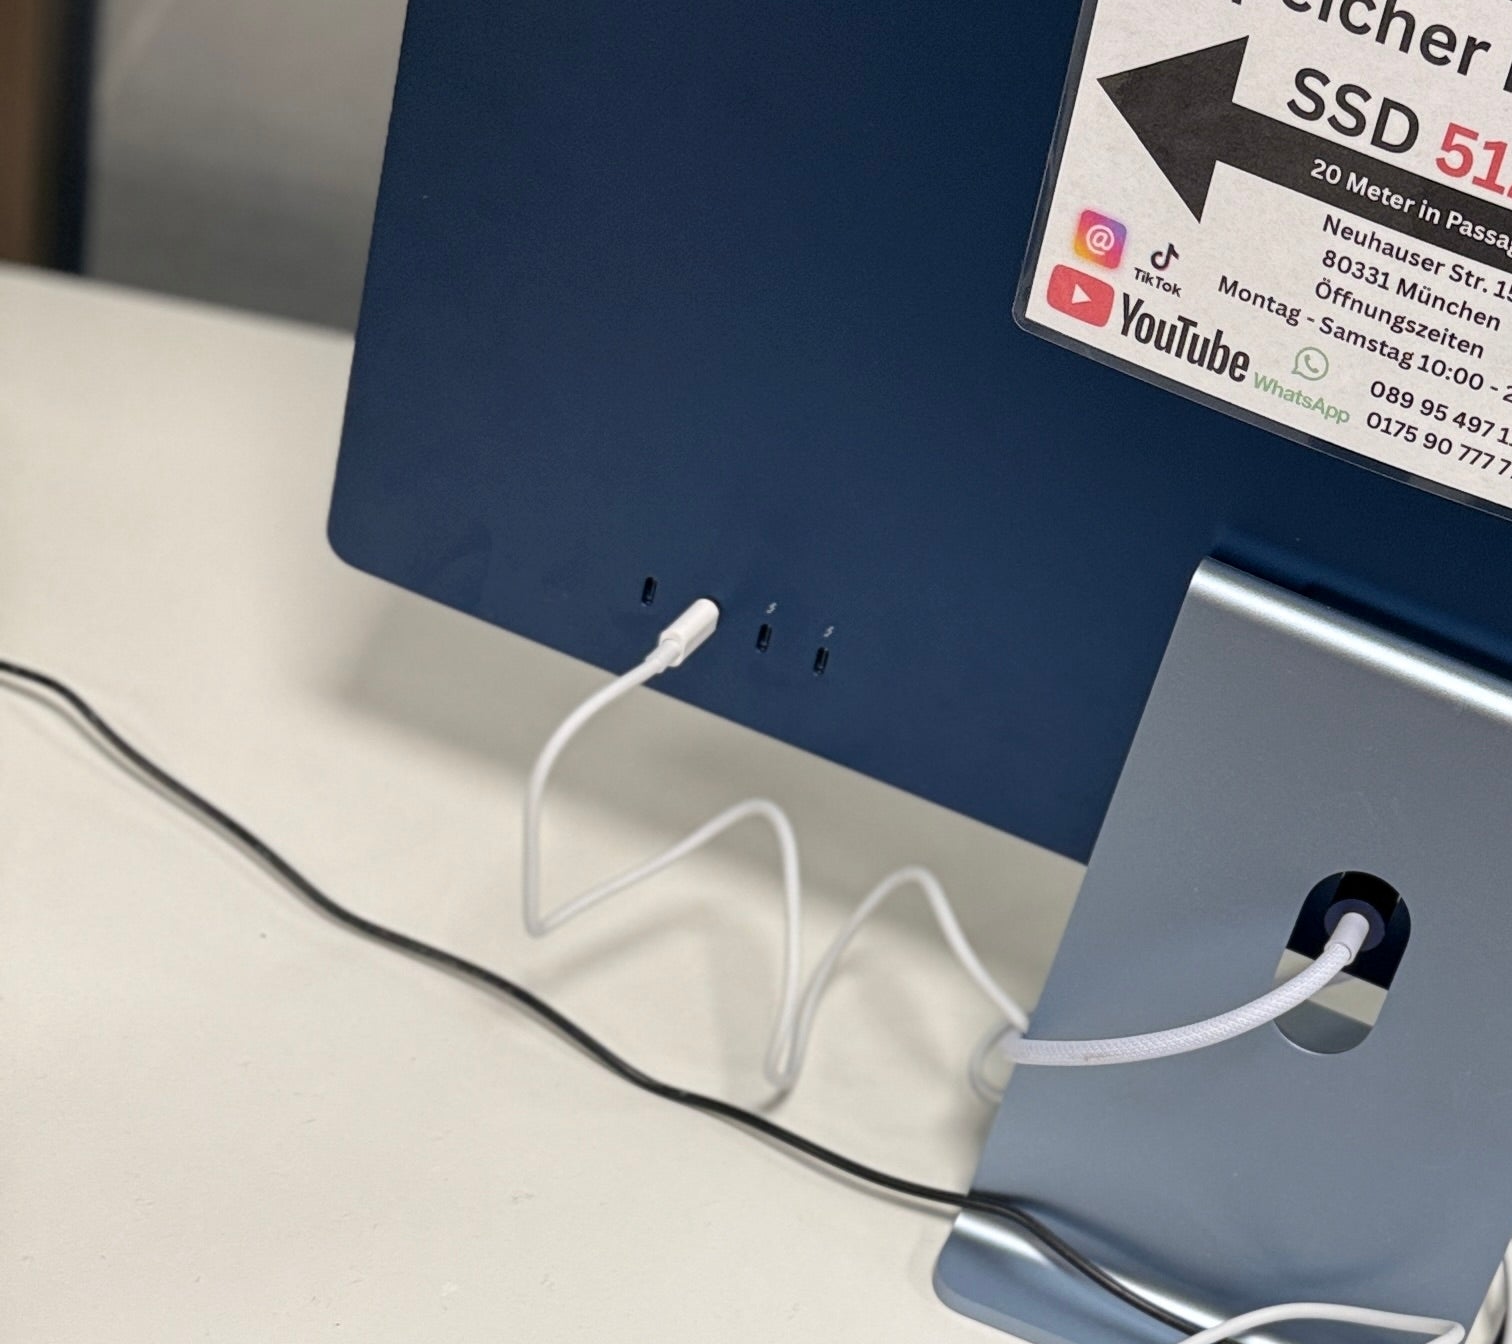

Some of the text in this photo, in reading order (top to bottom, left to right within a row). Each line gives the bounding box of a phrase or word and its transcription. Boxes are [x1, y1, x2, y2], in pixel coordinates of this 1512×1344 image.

[1287, 68, 1419, 153] SSD
[1310, 159, 1341, 184] 20
[1346, 172, 1415, 212] Meter
[1418, 199, 1440, 224] in
[1134, 267, 1181, 297] TikTok
[1322, 214, 1445, 275] Neuhauser
[1449, 264, 1487, 293] Str.
[1322, 250, 1500, 331] 80331 München
[1121, 292, 1249, 382] YouTube
[1218, 275, 1301, 326] Montag
[1319, 317, 1414, 370] Samstag
[1417, 355, 1483, 390] 10:00
[1315, 277, 1483, 359] Öffnungszeiten
[1254, 372, 1350, 424] WhatsApp
[1370, 381, 1414, 408] 089
[1420, 399, 1448, 421] 95
[1452, 412, 1495, 437] 497
[1367, 412, 1418, 442] 0175
[1423, 433, 1452, 455] 90
[1458, 444, 1495, 469] 777
